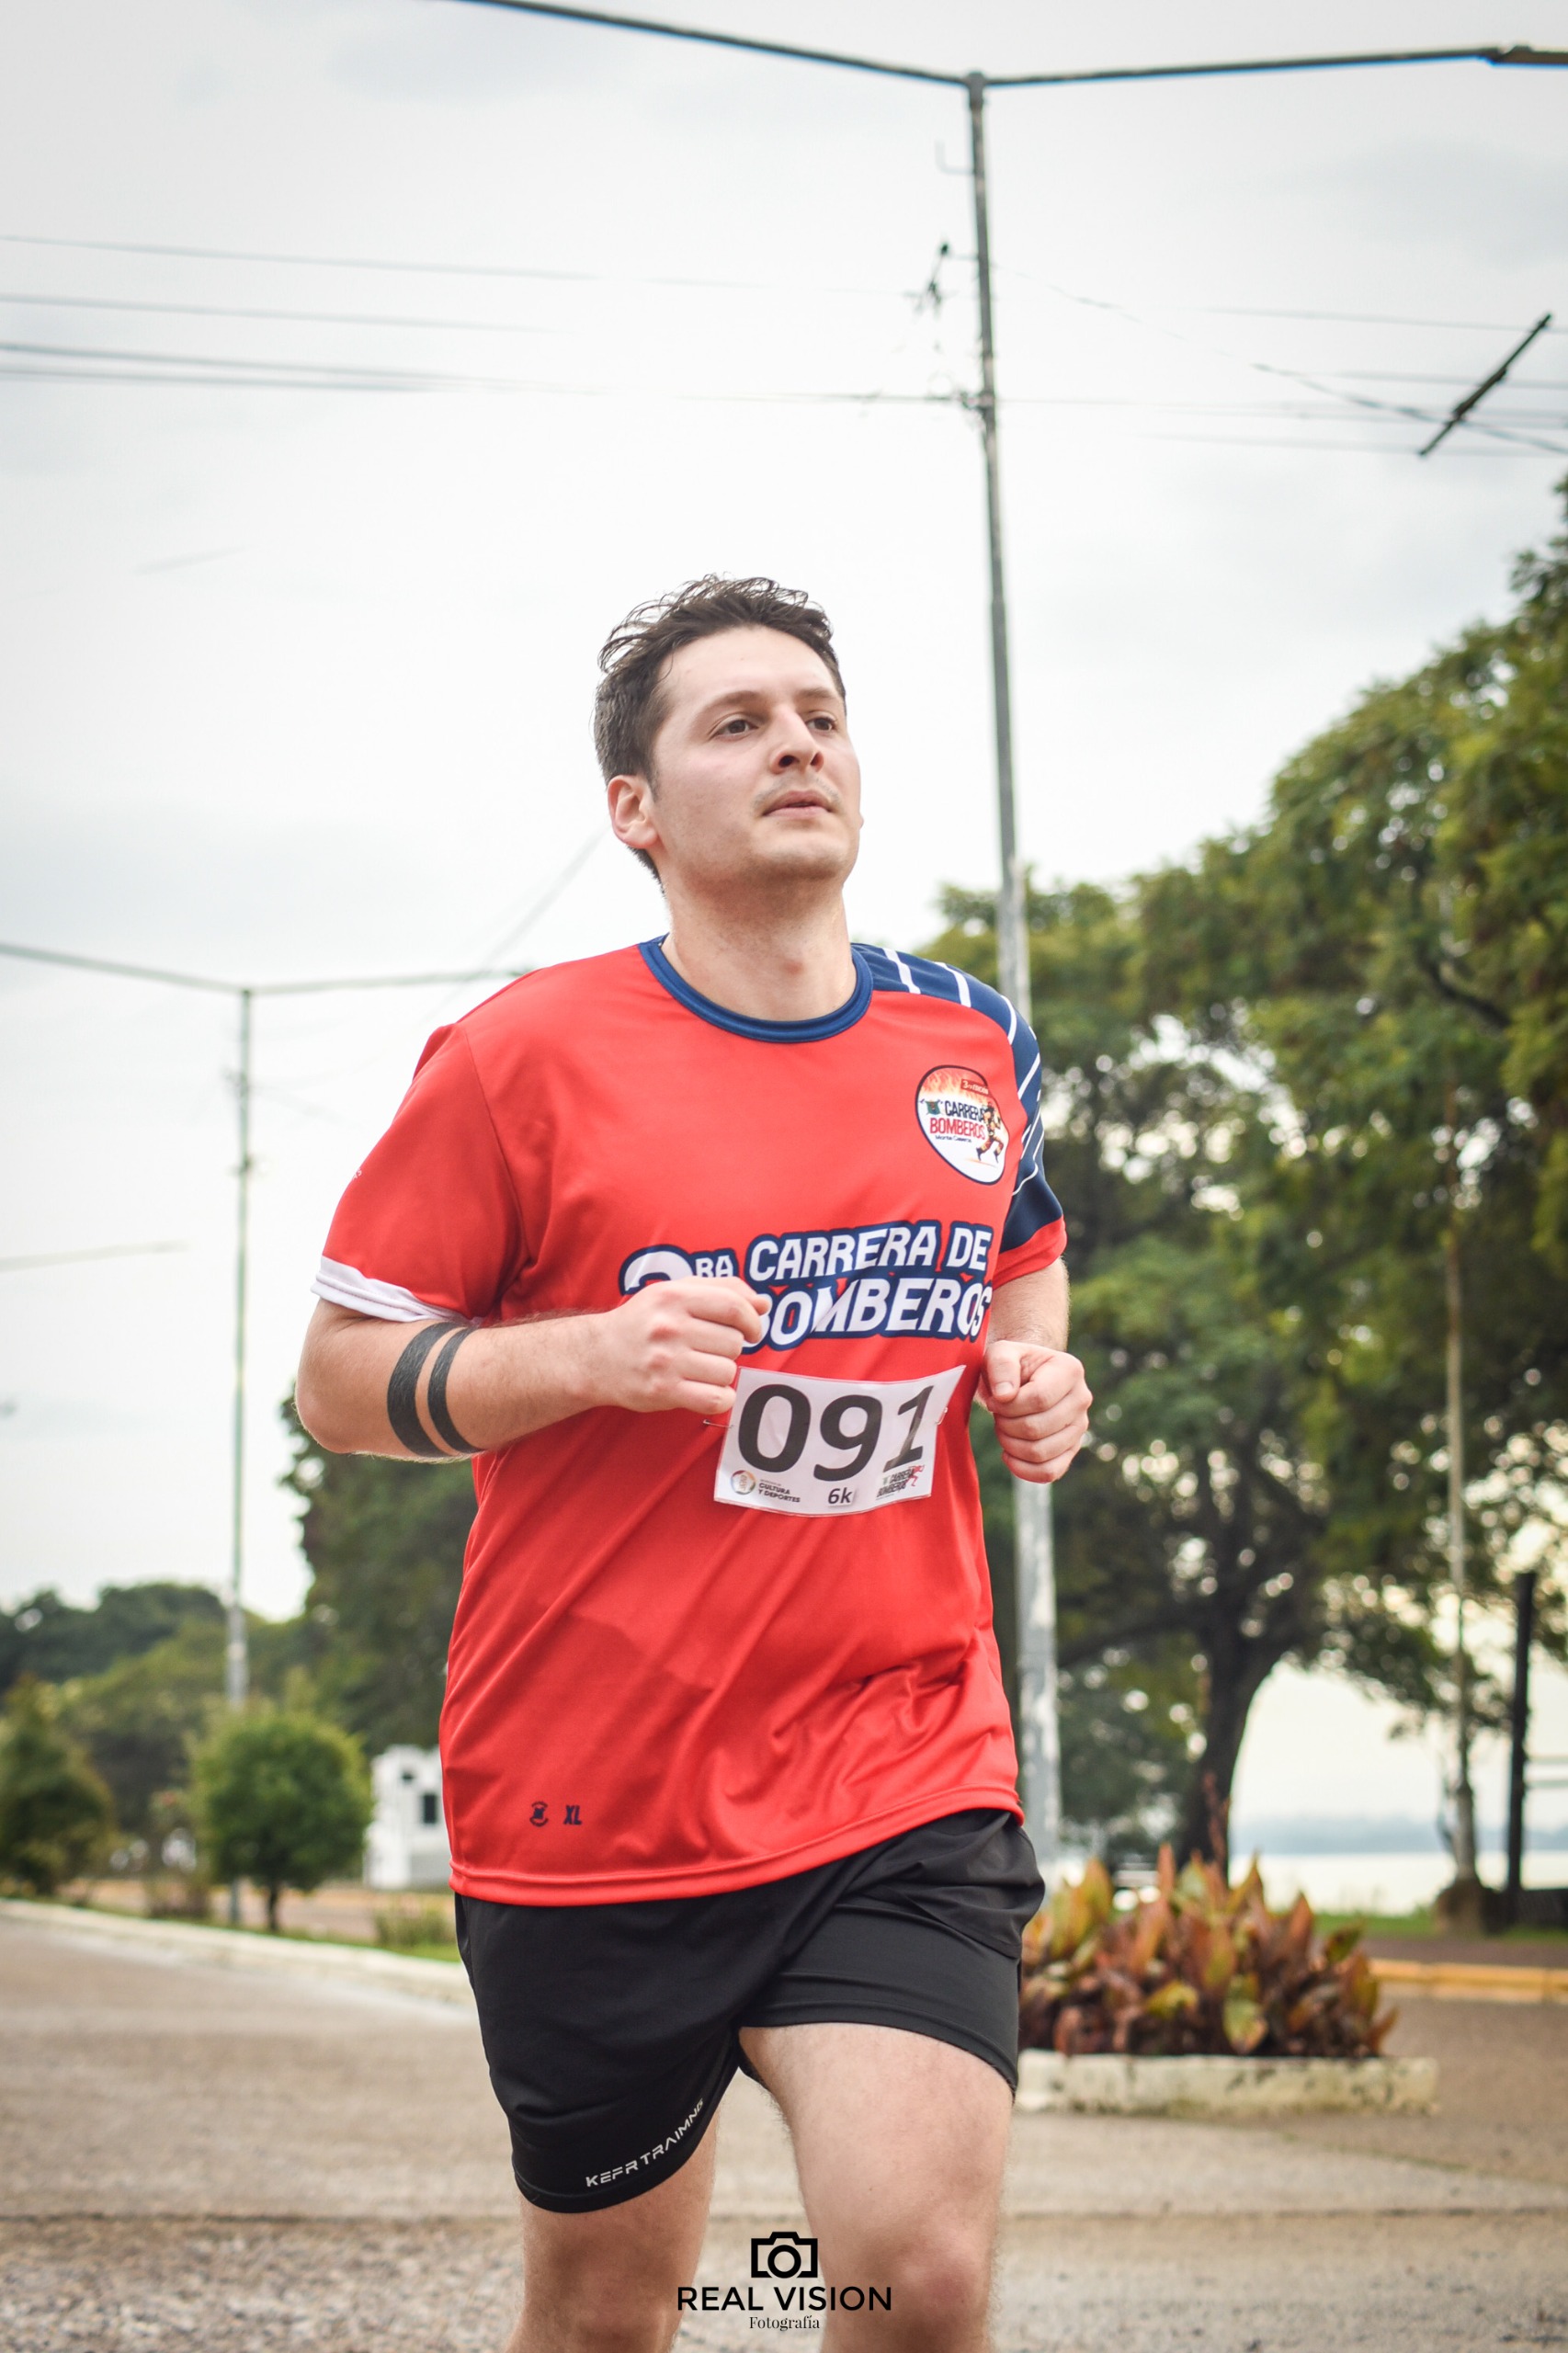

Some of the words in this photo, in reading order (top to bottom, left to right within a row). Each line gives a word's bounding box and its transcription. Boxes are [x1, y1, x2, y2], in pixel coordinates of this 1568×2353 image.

[929, 1117, 986, 1140] BOMBEROS
[749, 1225, 937, 1282] CARRERA
[946, 1227, 992, 1271] DE
[738, 1383, 935, 1482] 091
[759, 1482, 790, 1495] CULTURA
[764, 1490, 801, 1503] DEPORTES
[827, 1487, 853, 1504] 6k
[562, 1804, 583, 1825] XL
